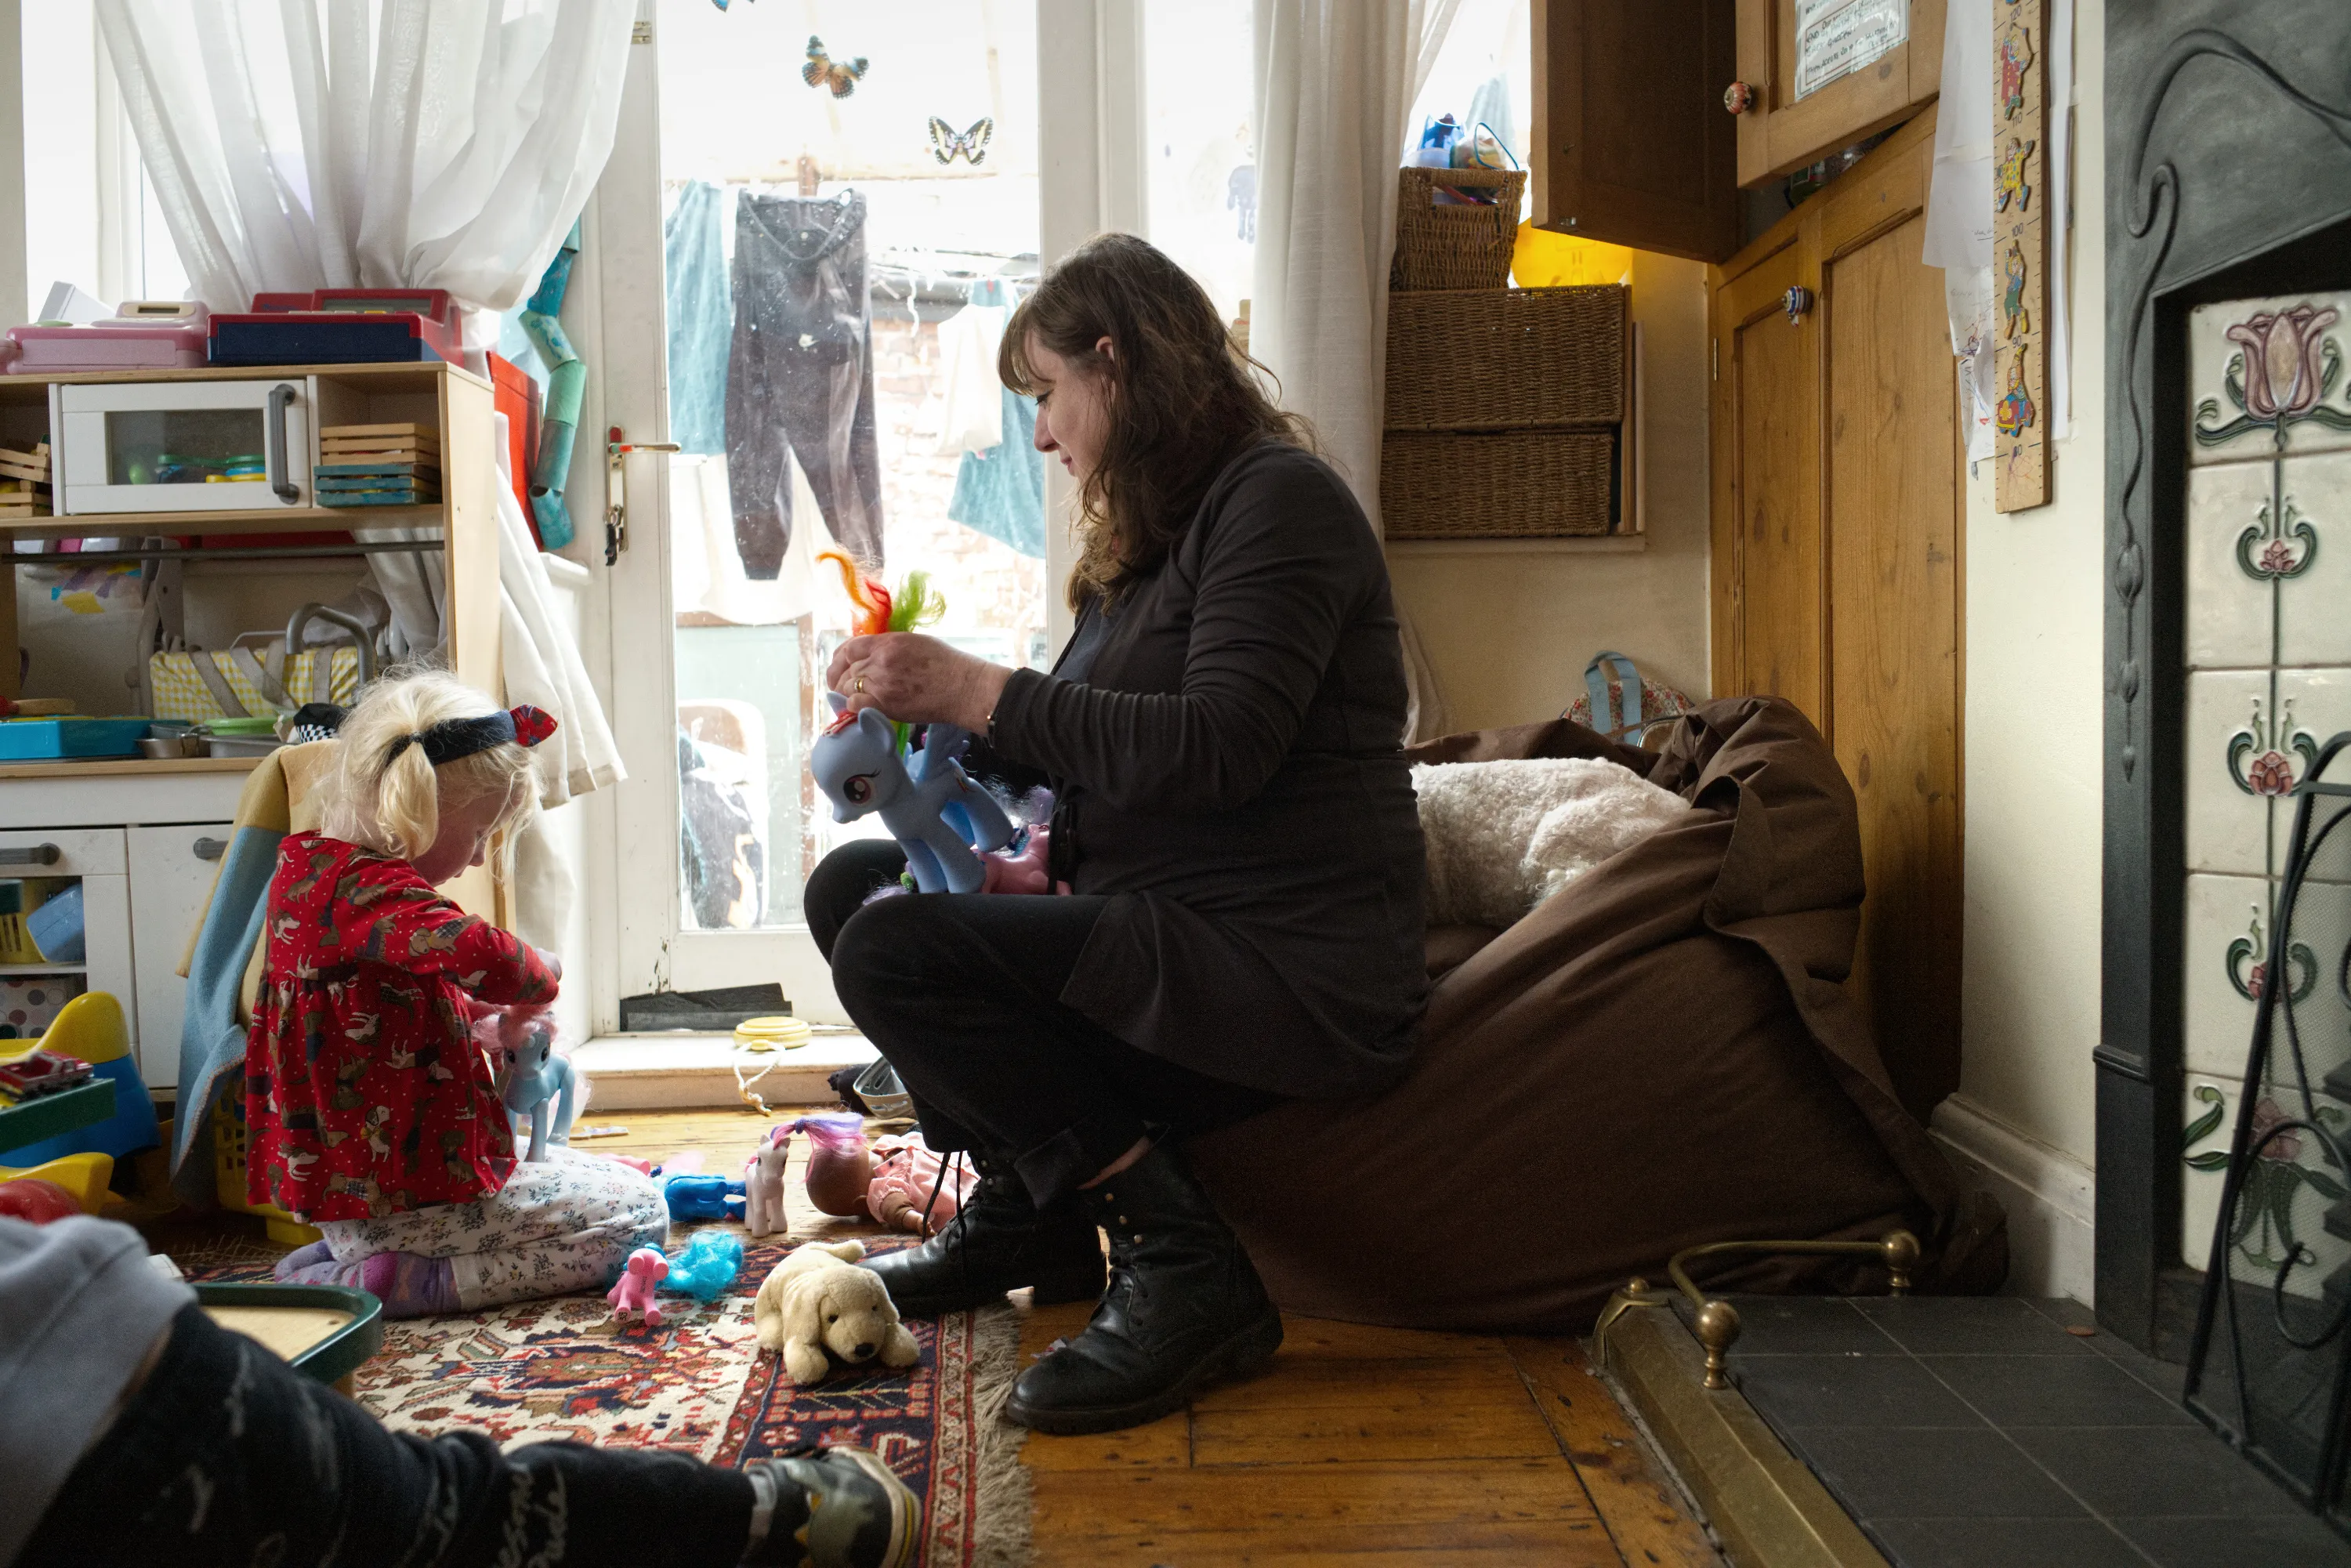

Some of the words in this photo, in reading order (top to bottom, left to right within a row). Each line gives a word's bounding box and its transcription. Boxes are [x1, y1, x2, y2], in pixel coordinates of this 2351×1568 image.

[2009, 5, 2022, 22] 120
[2012, 112, 2023, 129] 110
[2012, 223, 2023, 238] 100
[2012, 335, 2022, 349] 90
